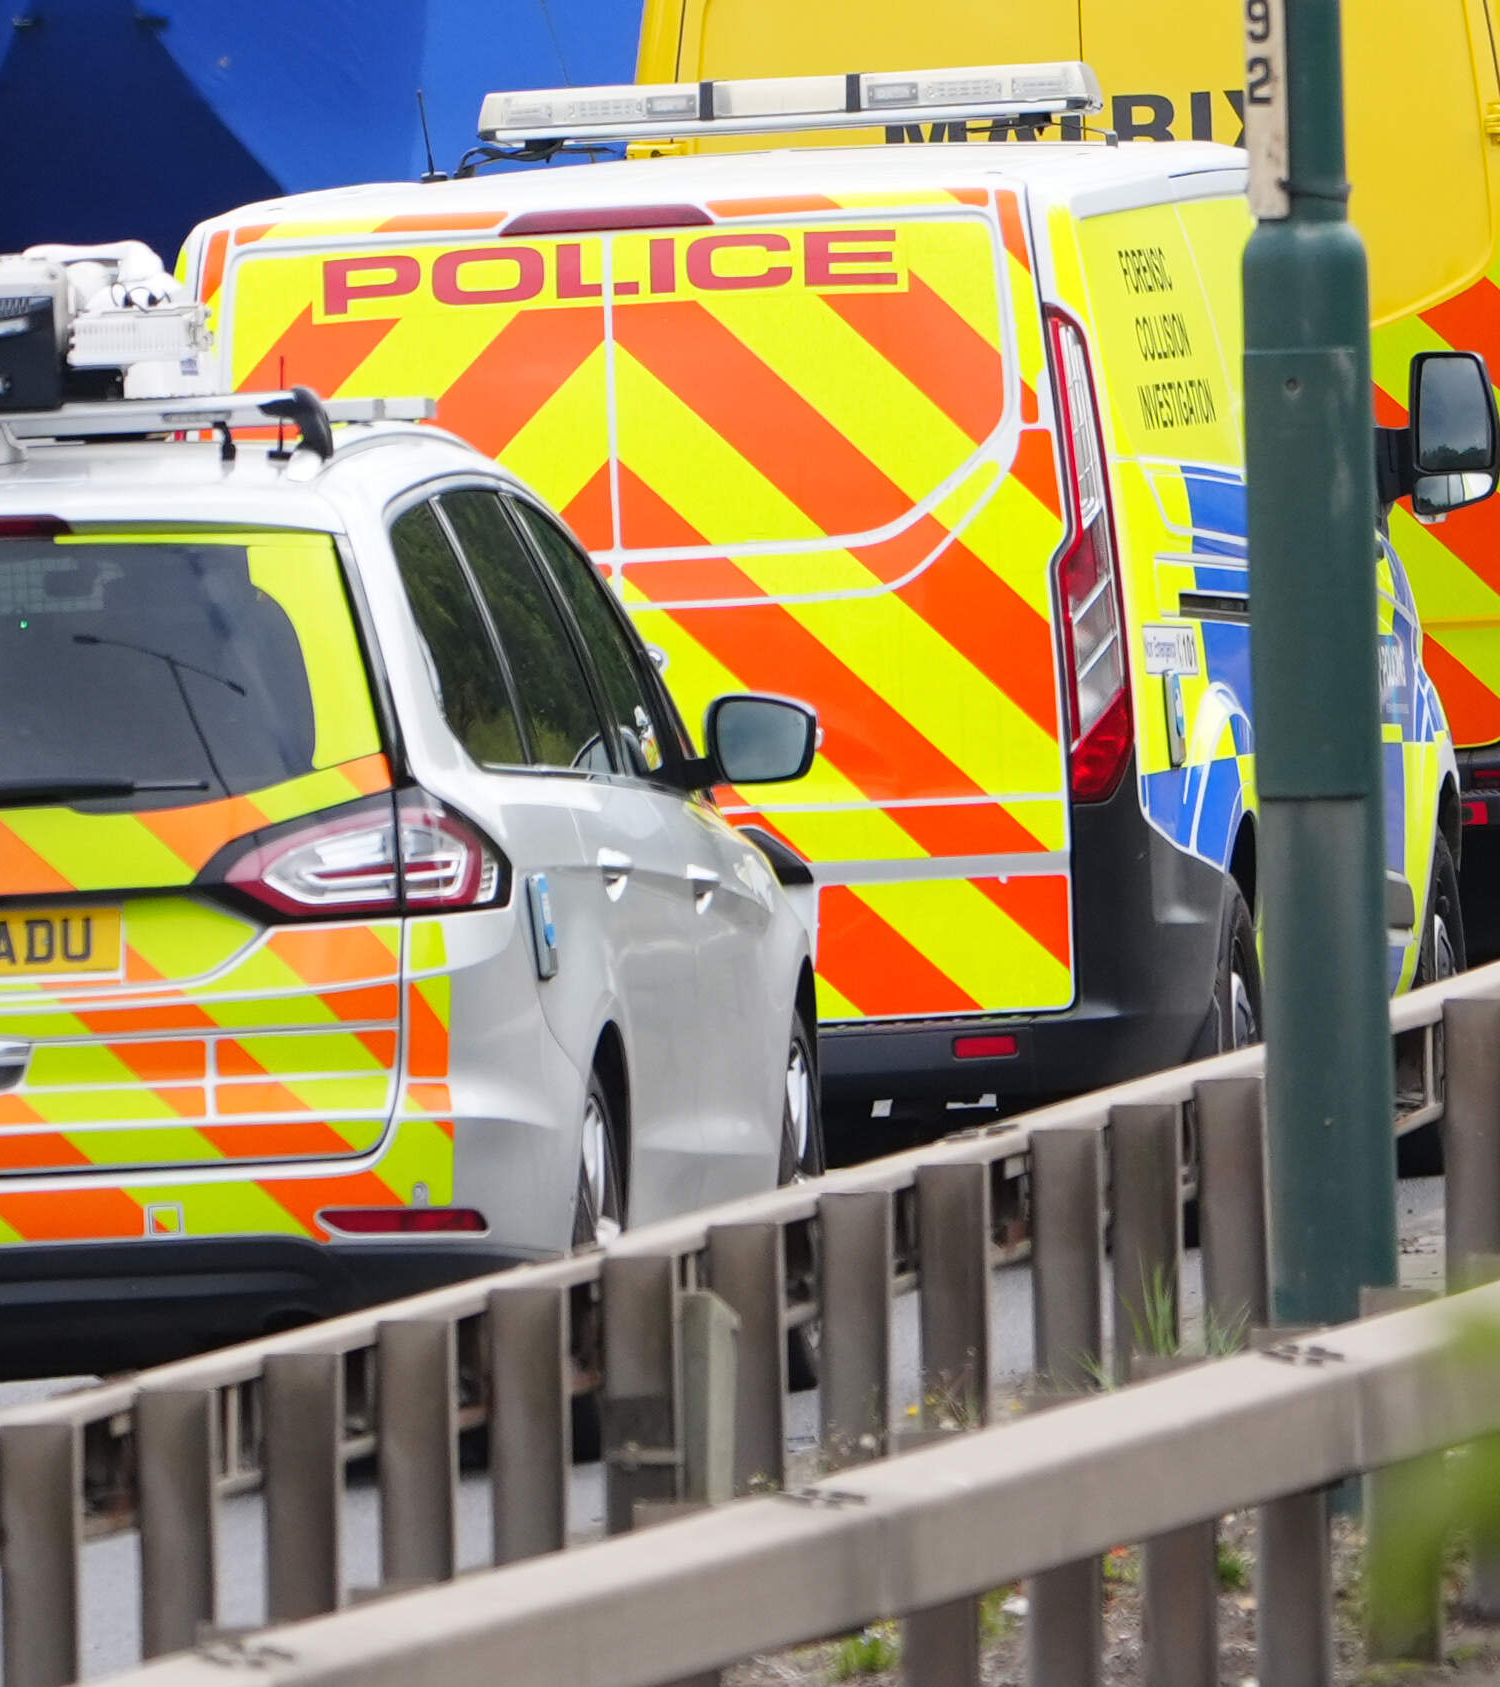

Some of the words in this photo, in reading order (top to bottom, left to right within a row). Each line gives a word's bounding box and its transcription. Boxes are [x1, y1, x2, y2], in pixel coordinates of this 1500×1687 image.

[322, 229, 898, 315] POLICE
[1117, 247, 1173, 295] FORENSIC
[1135, 313, 1193, 362] COLLISION
[1137, 378, 1217, 431] INVESTIGATION
